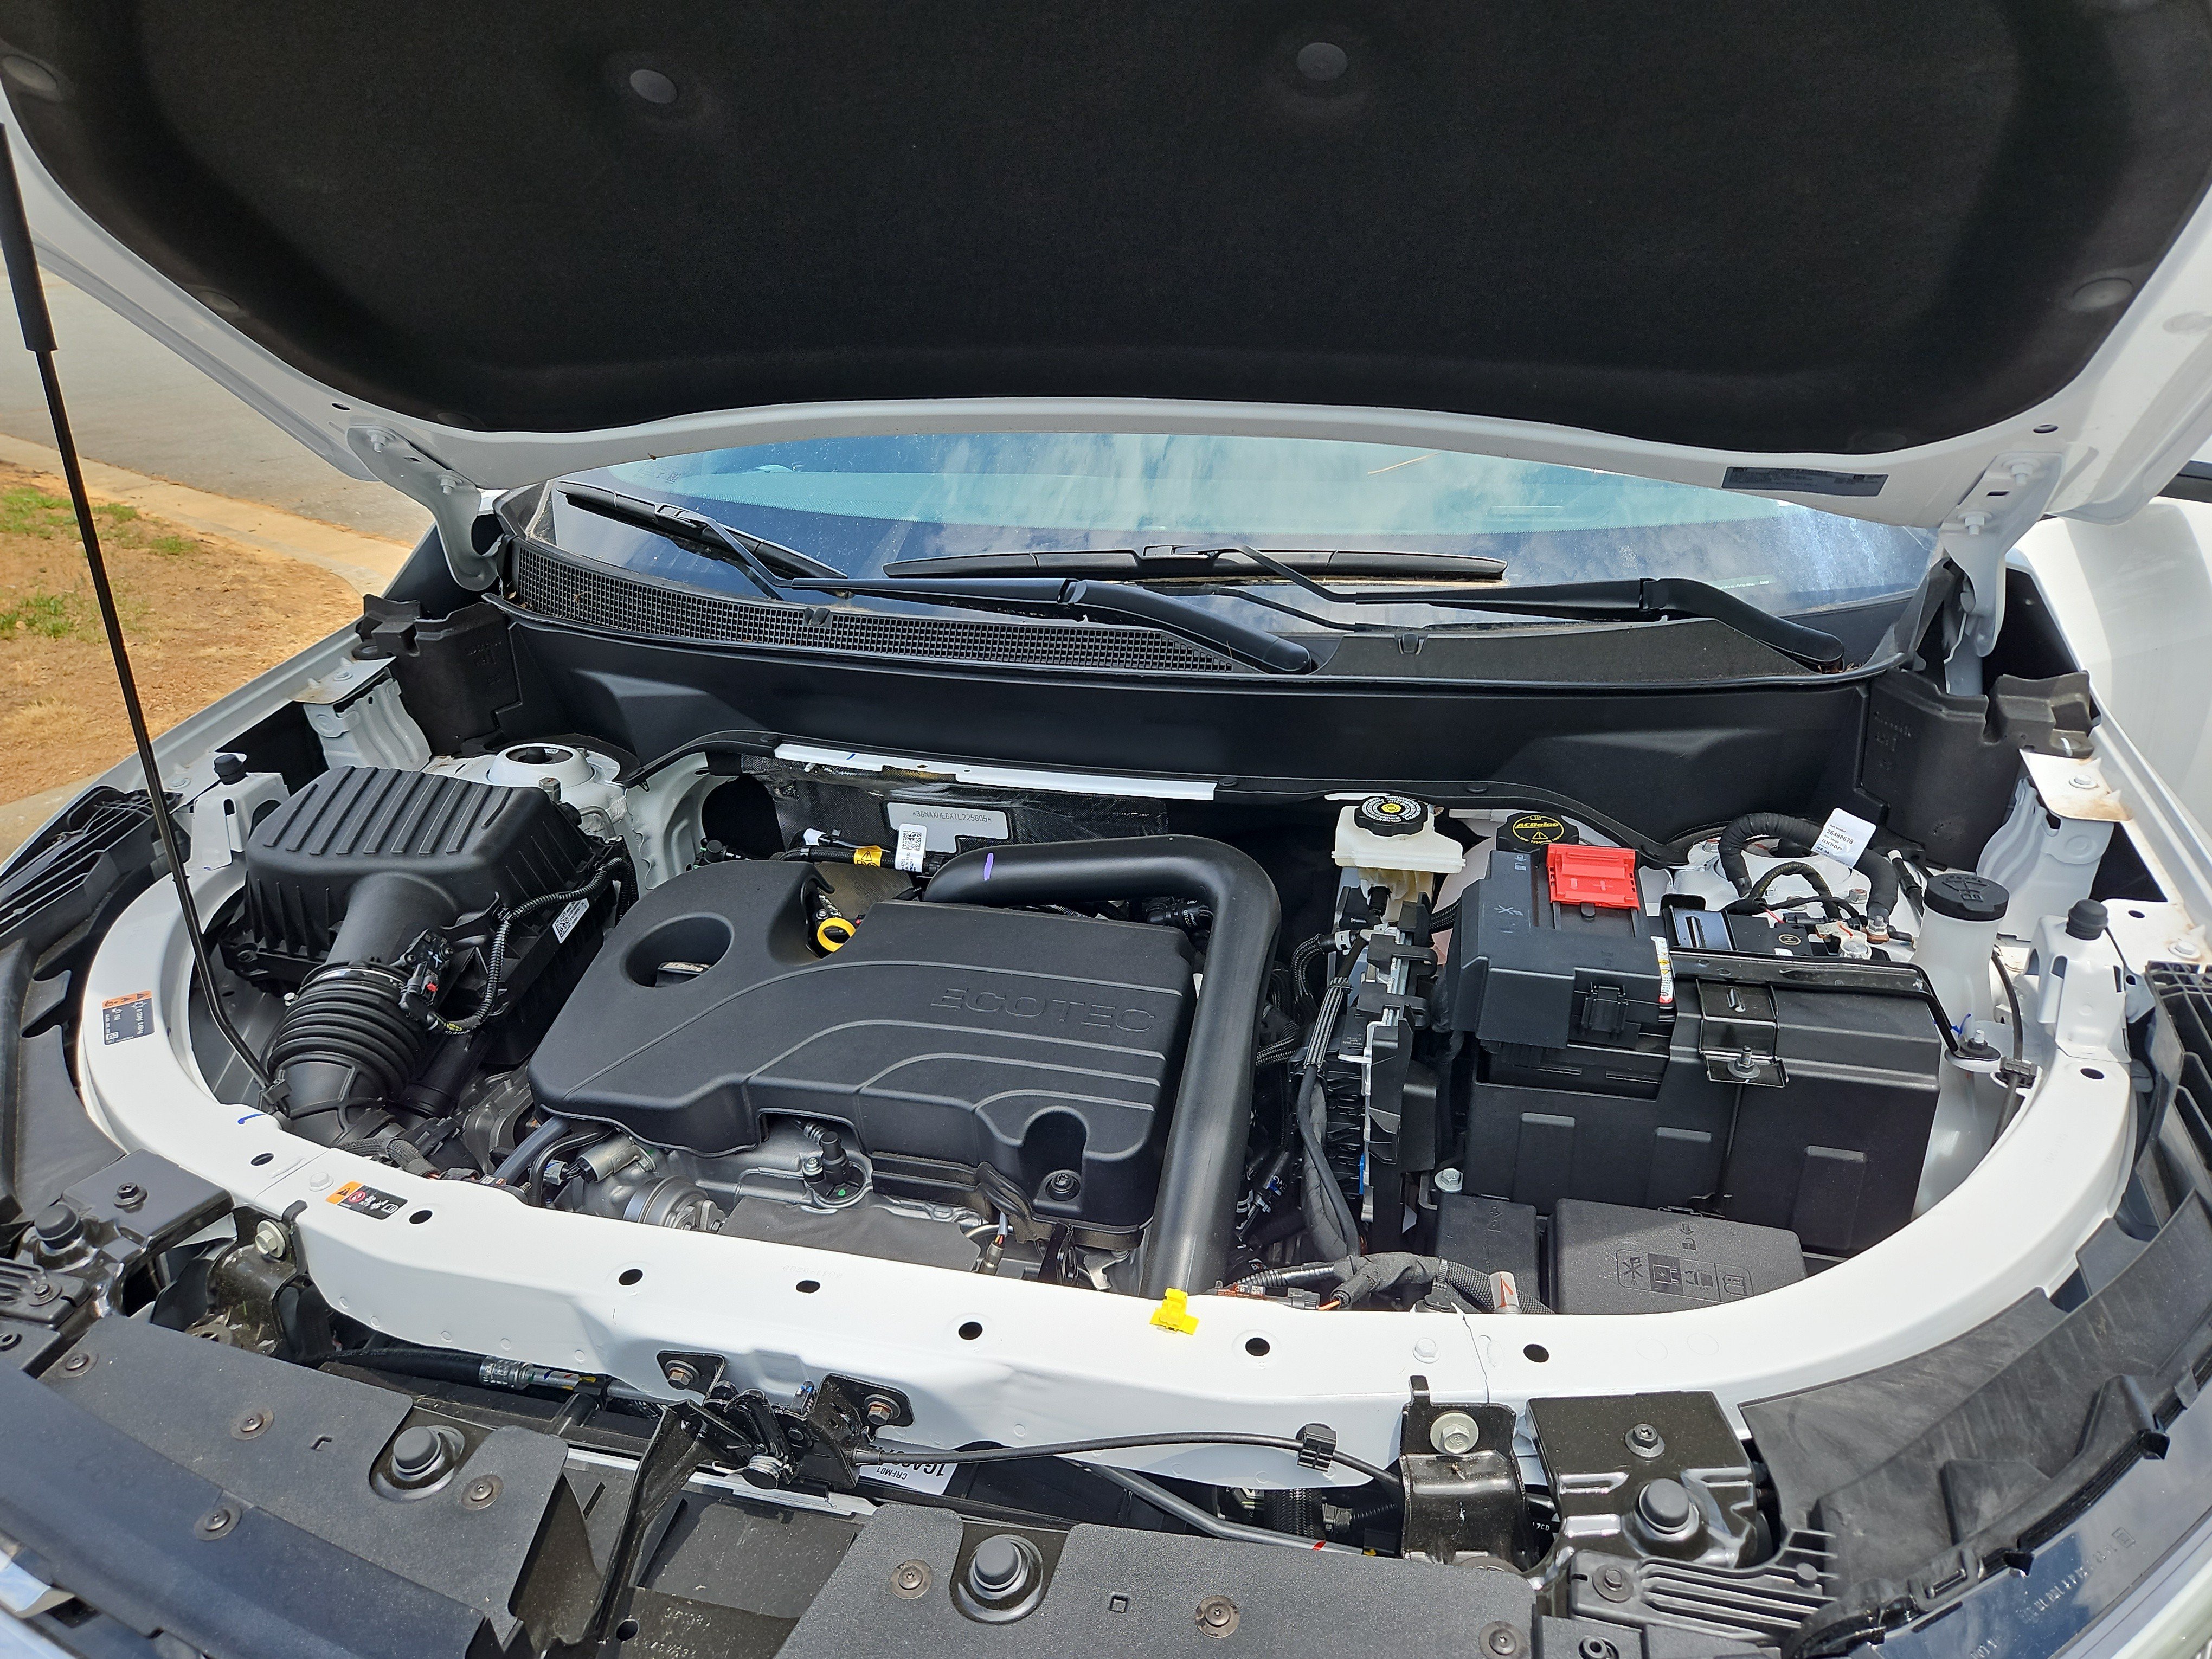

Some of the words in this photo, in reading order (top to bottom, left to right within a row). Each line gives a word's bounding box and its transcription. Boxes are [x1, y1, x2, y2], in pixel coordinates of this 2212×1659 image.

[1826, 829, 1854, 845] 26488678
[930, 987, 1155, 1032] ECOTEC
[876, 1466, 908, 1480] CRFM01
